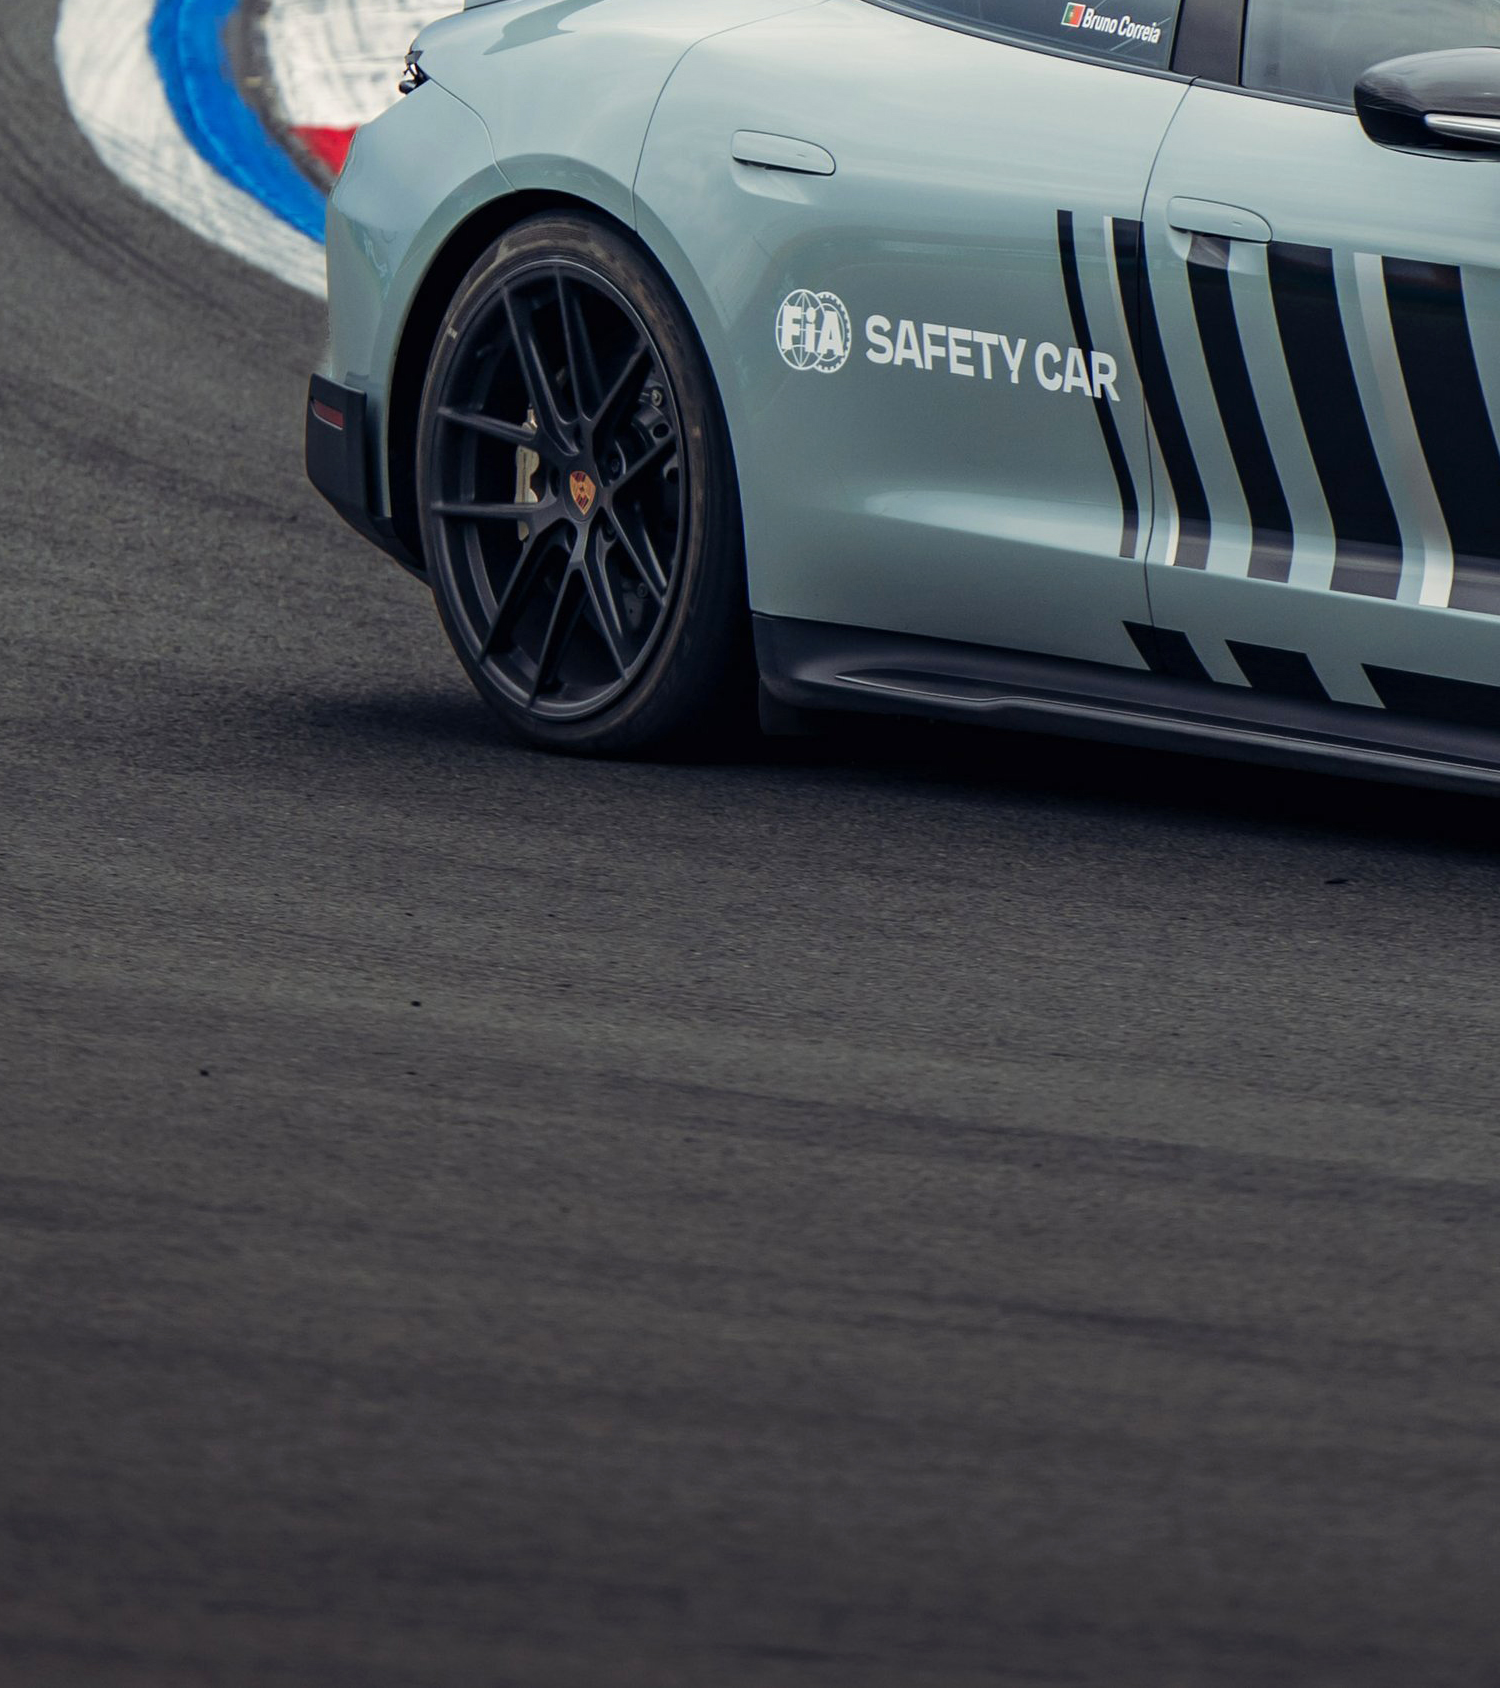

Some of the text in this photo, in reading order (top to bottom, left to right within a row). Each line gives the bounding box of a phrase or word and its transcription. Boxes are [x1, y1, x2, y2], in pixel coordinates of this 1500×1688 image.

[1081, 7, 1161, 44] Bruno Correia
[865, 314, 1026, 384] SAFETY
[1034, 341, 1121, 402] CAR
